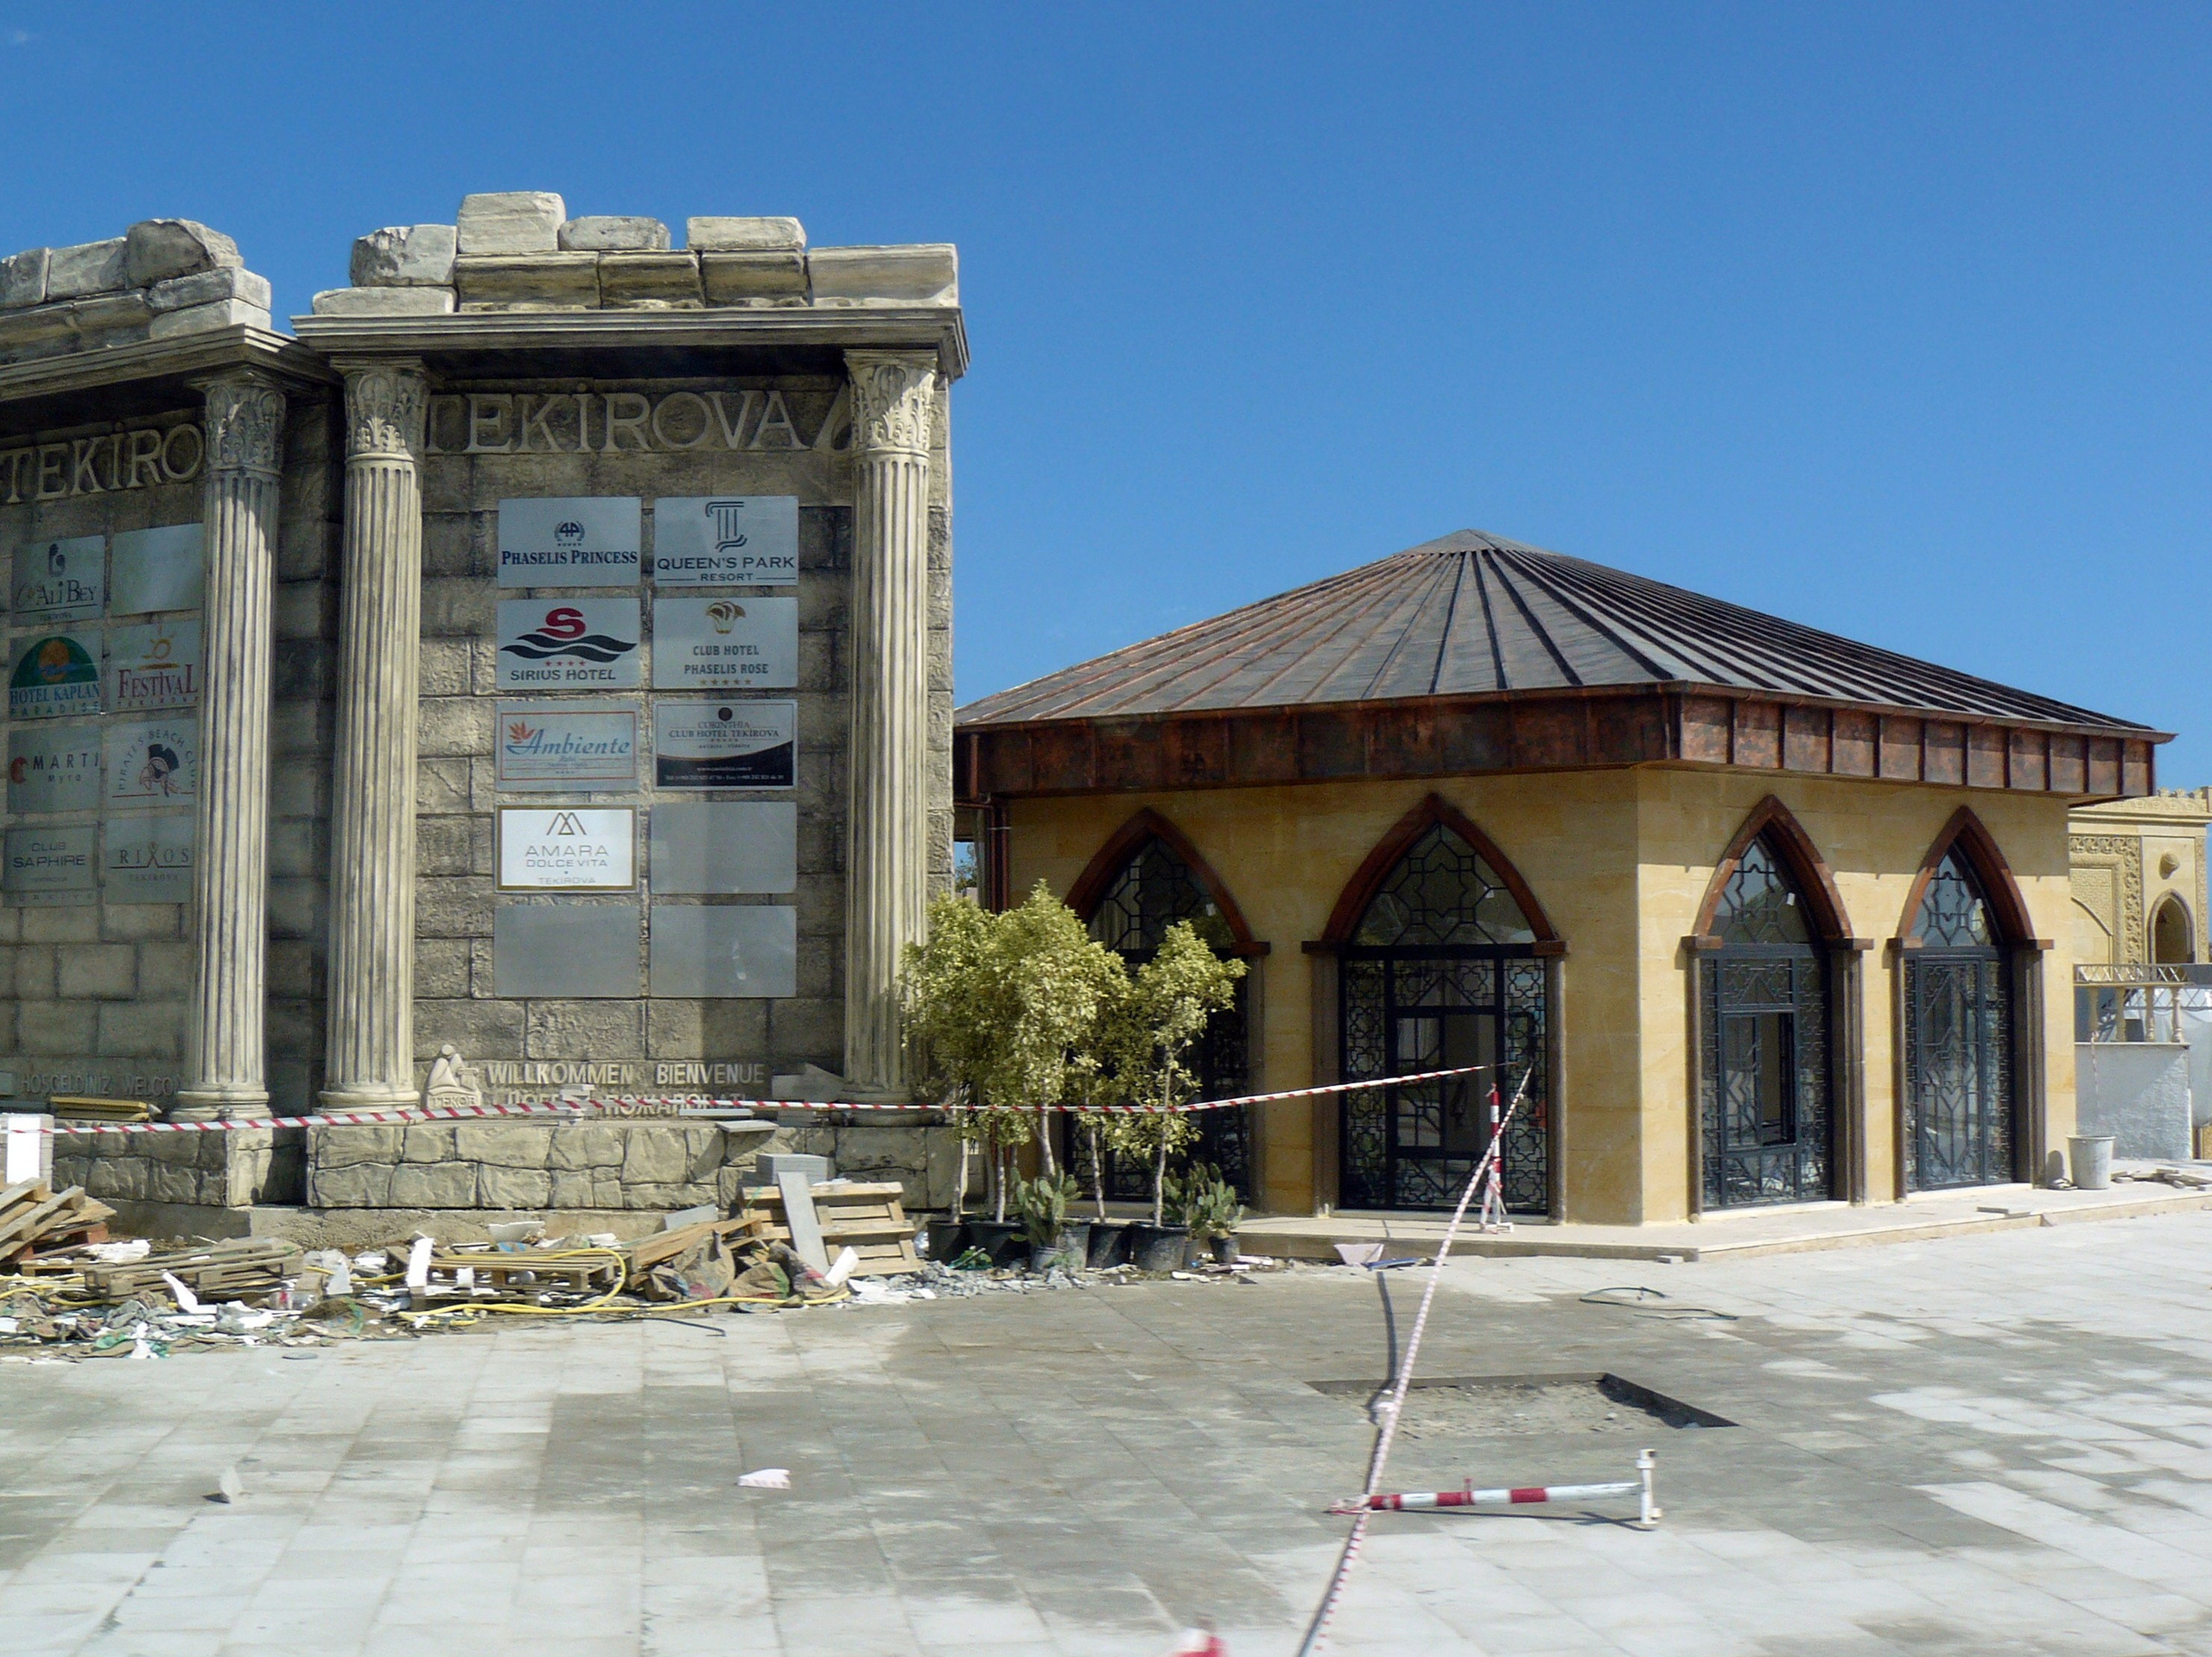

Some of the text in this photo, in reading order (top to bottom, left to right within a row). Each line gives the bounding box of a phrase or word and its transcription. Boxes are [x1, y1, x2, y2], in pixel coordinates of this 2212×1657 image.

[501, 549, 639, 566] PHASELIS PRINCESS
[657, 556, 795, 570] QUEEN'S PARK
[700, 573, 754, 581] RESORT
[692, 645, 760, 657] CLUB HOTEL
[511, 669, 616, 682] SIRIUS HOTEL
[683, 663, 769, 675] PHASELIS ROSE
[10, 682, 100, 705] HOTEL KAPLAN
[148, 728, 185, 747] BEACH
[669, 730, 694, 739] CLUB
[697, 729, 728, 738] HOTEL
[505, 728, 631, 755] Ambiente
[119, 841, 190, 867] RIXOS
[524, 845, 609, 857] AMARA
[525, 859, 608, 868] DOLCE VITA
[486, 1063, 766, 1085] WILLKOMMEN BIENVENUE
[124, 1076, 180, 1096] WELCO
